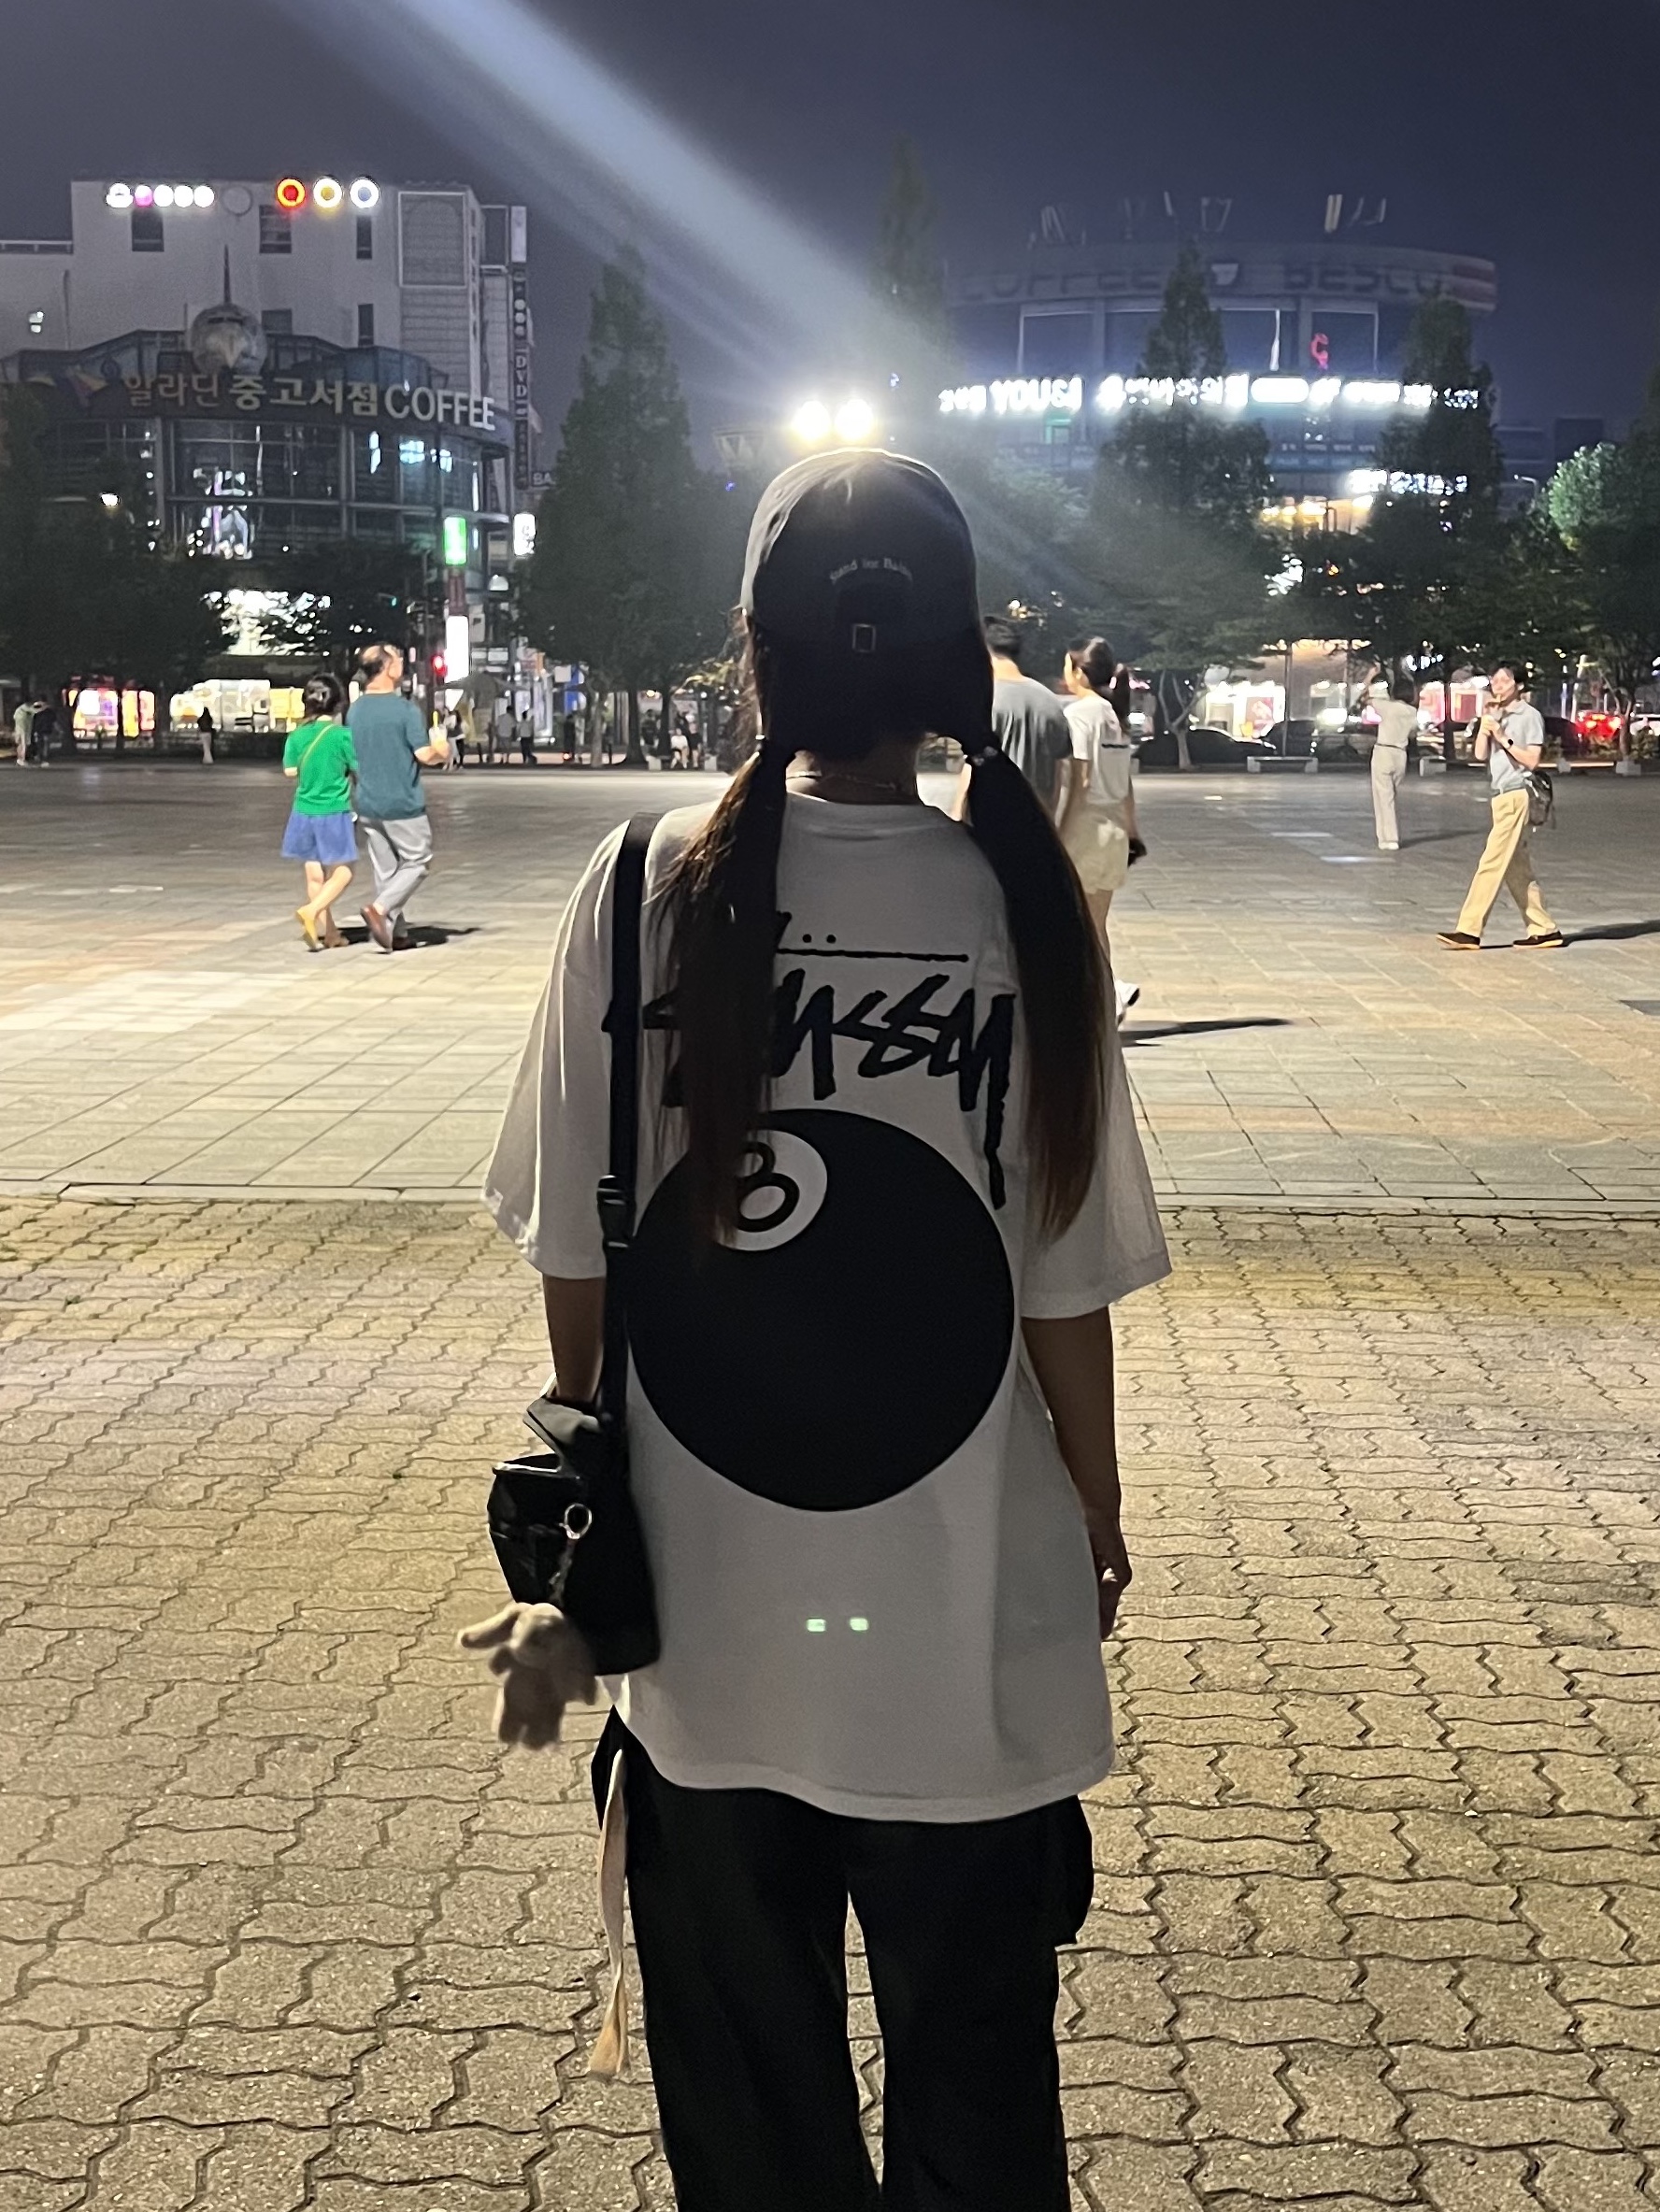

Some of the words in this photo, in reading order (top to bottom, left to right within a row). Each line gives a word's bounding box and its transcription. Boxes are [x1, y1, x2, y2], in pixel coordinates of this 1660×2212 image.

[124, 372, 221, 409] 알라딘
[229, 373, 379, 417] 중고서점
[384, 384, 496, 431] COFFEE
[533, 471, 557, 486] BA
[736, 1141, 800, 1233] 8
